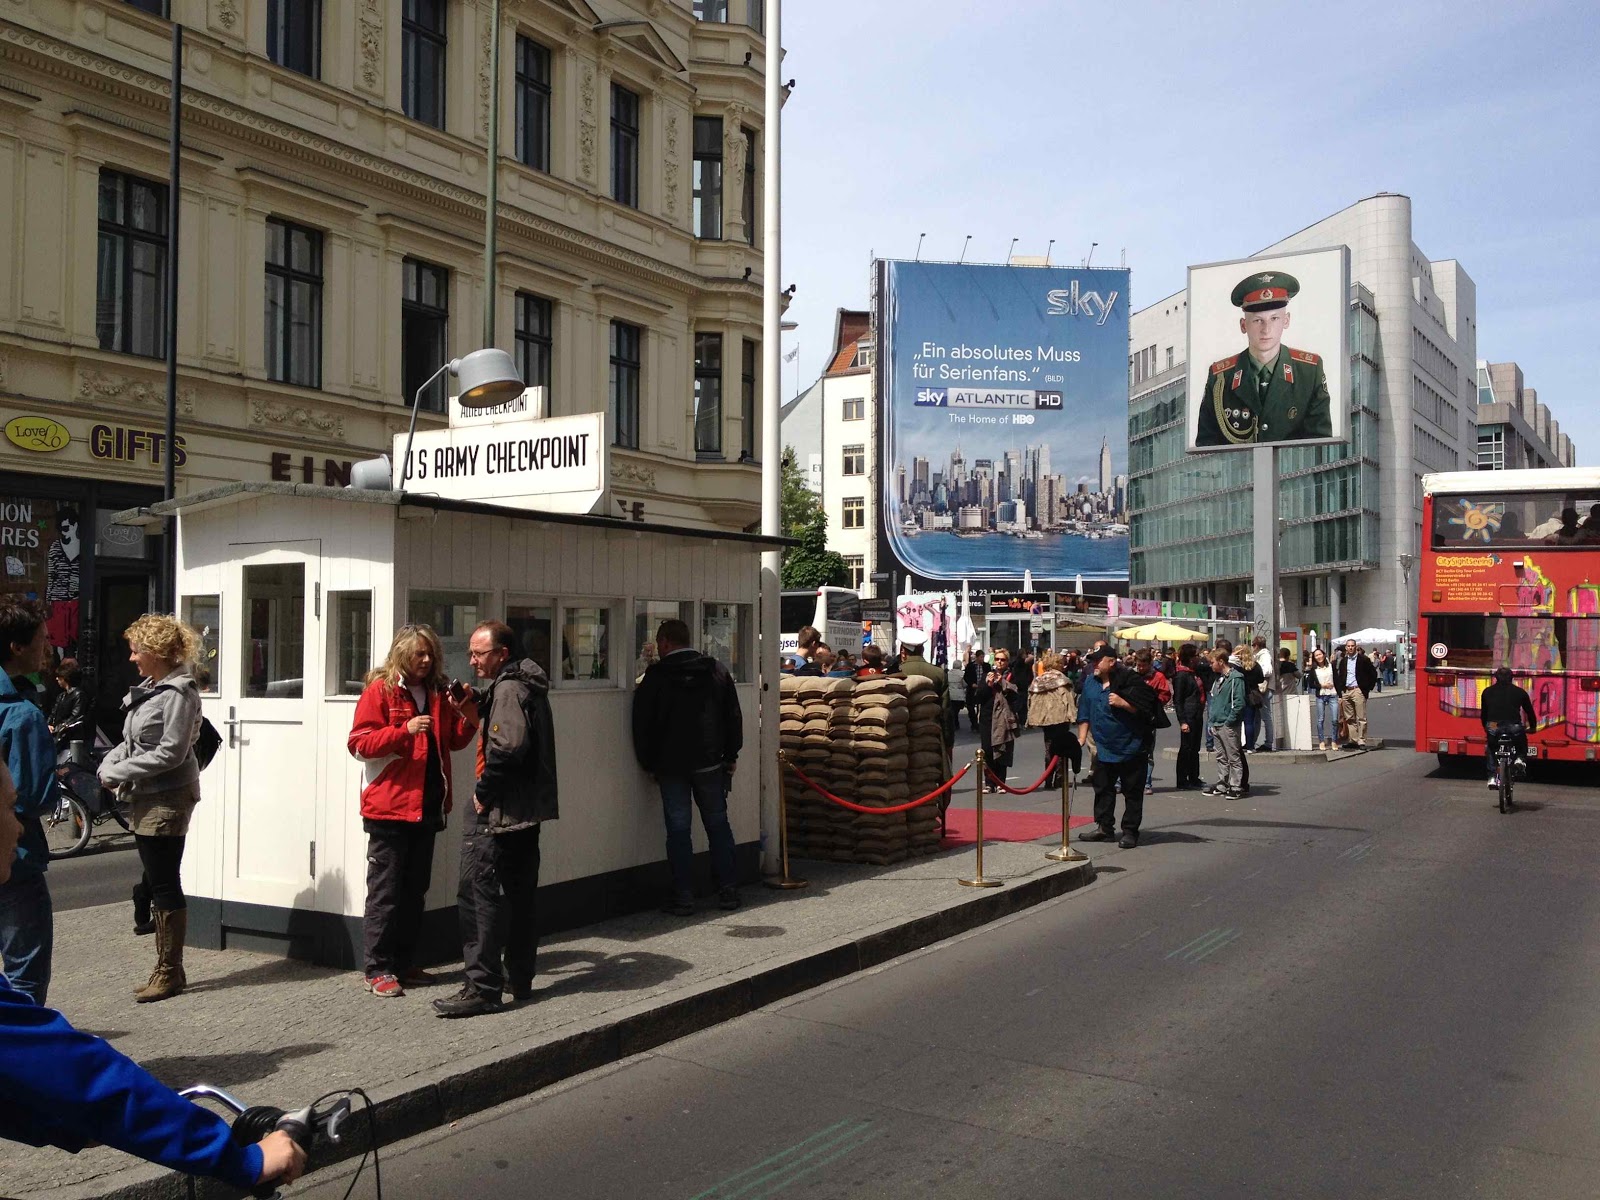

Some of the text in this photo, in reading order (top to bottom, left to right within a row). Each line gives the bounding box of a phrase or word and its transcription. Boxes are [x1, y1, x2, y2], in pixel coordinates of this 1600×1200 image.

[1047, 280, 1118, 326] sky
[950, 344, 1032, 361] absolutes
[1038, 346, 1081, 362] Muss
[913, 363, 935, 379] für
[485, 394, 528, 416] CHECKPOINT
[917, 388, 1061, 406] sky ATLANTIC HD
[949, 413, 1035, 425] The Home of HBO
[15, 425, 45, 438] Love
[91, 424, 187, 467] GIFTS
[434, 444, 480, 479] ARMY
[486, 433, 589, 475] CHECKPOINT
[0, 503, 32, 523] ION
[1, 527, 40, 549] RES
